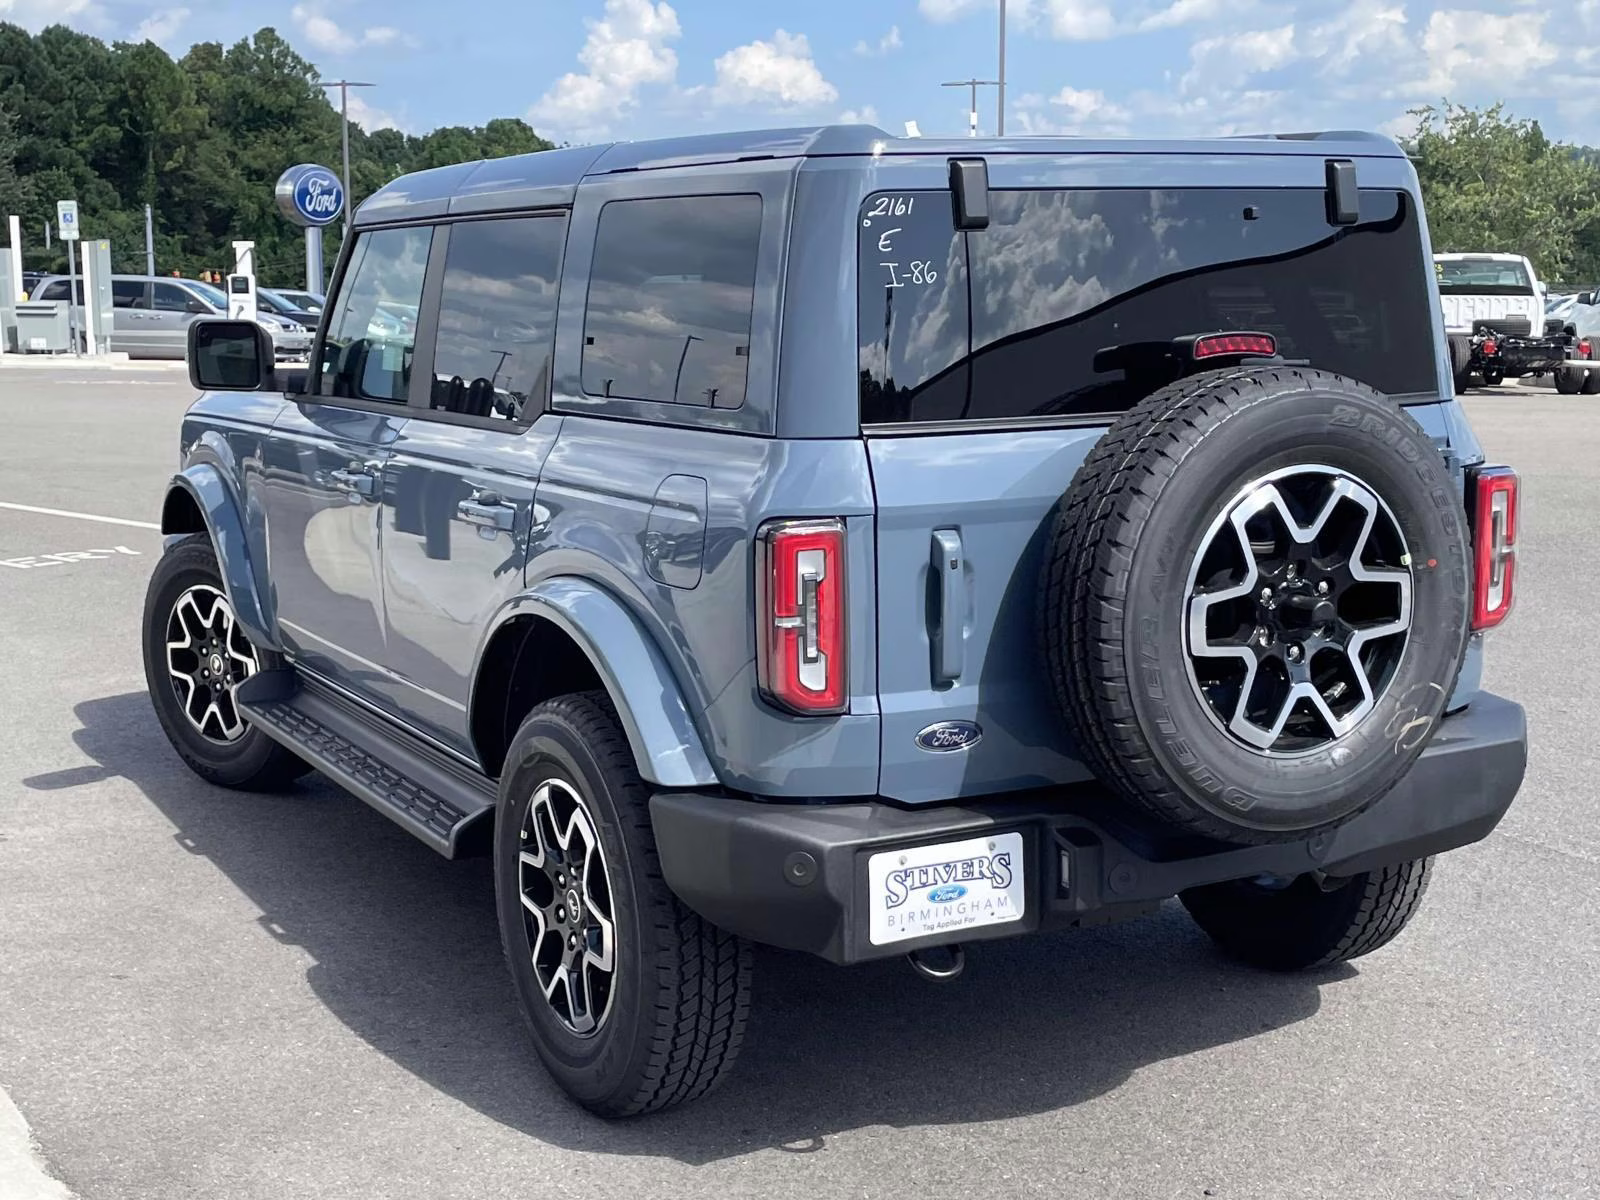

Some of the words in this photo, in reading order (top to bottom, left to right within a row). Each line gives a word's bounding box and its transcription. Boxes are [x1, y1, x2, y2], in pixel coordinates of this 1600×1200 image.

[305, 177, 337, 212] Ford
[868, 197, 914, 217] 2161
[878, 227, 902, 252] E
[879, 260, 938, 288] I-86
[931, 727, 969, 746] Ford
[885, 852, 1013, 909] STIVERS
[932, 886, 962, 902] Ford
[887, 895, 1009, 927] BIRMINGHAM
[923, 923, 935, 932] Tag
[936, 917, 962, 930] Applied
[963, 916, 976, 924] For
